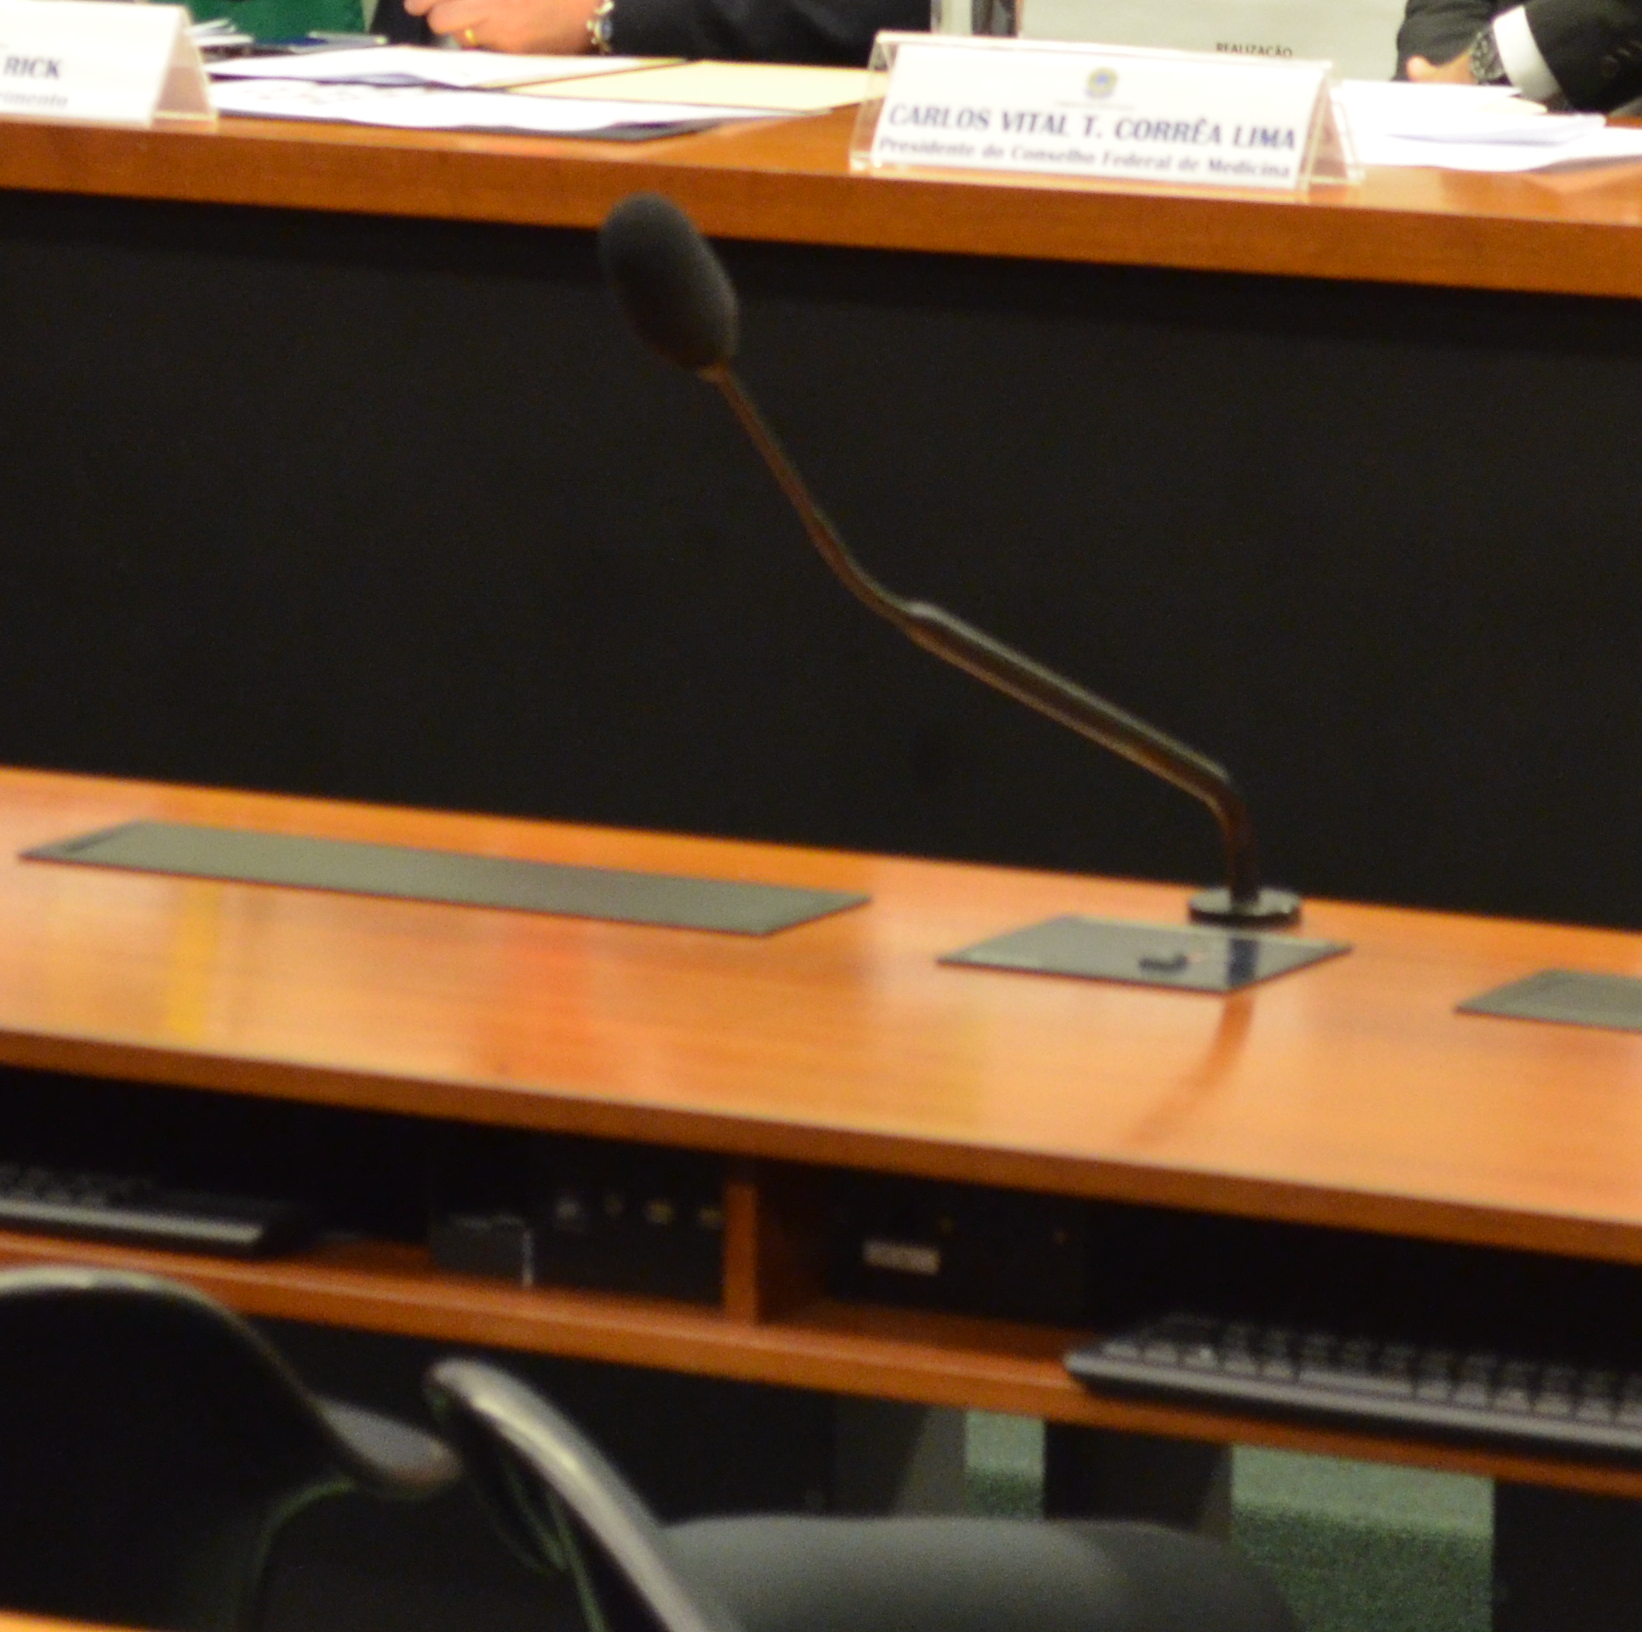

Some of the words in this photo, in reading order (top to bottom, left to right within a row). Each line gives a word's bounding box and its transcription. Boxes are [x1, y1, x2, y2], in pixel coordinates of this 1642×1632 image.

[4, 55, 62, 80] RICK
[888, 103, 989, 131] CARLOS
[1001, 111, 1071, 138] VITAL
[1082, 116, 1103, 140] T.
[1114, 116, 1222, 146] CORRÊA
[1233, 125, 1296, 150] LIMA
[878, 136, 975, 159] Presidente
[982, 142, 1005, 161] do
[1011, 143, 1095, 166] Conselho
[1103, 147, 1172, 171] Federal
[1178, 152, 1200, 173] de
[1208, 155, 1291, 179] Medicina
